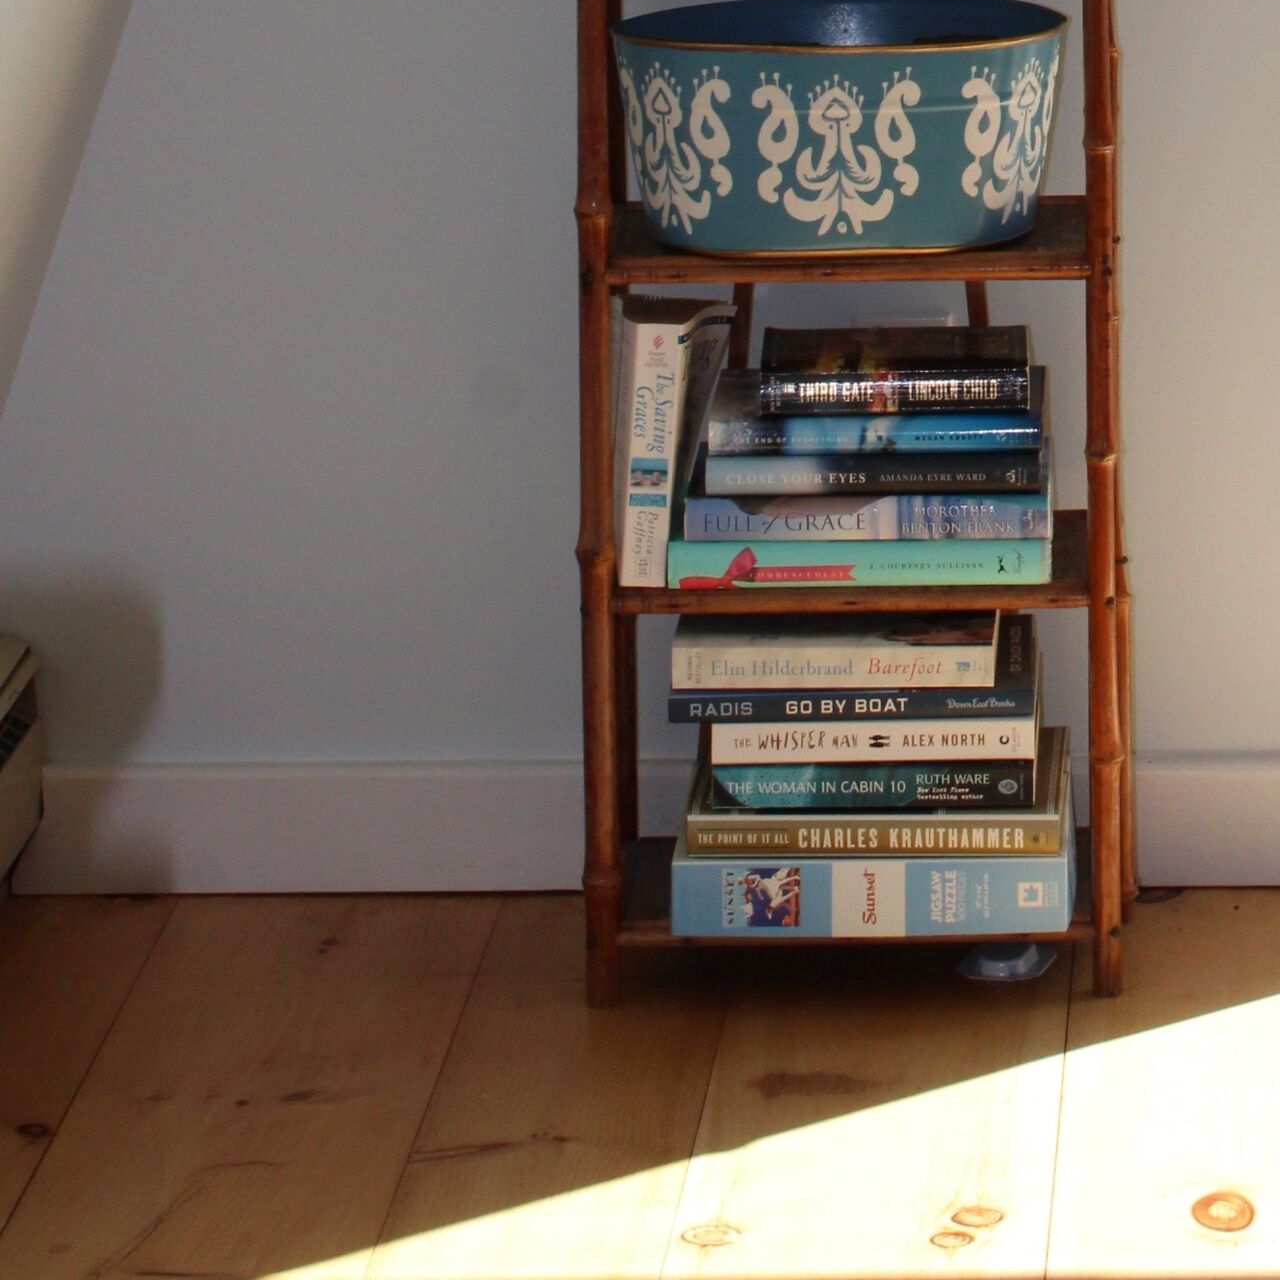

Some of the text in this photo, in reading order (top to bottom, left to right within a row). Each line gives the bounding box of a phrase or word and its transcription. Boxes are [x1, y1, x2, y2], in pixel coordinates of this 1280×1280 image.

[655, 372, 676, 395] The
[799, 382, 838, 403] THIRD
[842, 381, 874, 402] GATE
[908, 380, 959, 401] LINCOLN
[962, 379, 998, 400] CHILD
[633, 386, 655, 439] Graces
[647, 397, 674, 454] Saving
[755, 436, 773, 444] END
[776, 436, 787, 444] OF
[726, 472, 867, 485] CLOSE YOUR EYES
[879, 471, 986, 482] AMANDA EYRE WARD
[914, 505, 998, 518] DOROTHEA
[632, 511, 648, 555] Gaffney
[645, 511, 659, 555] Patricia
[703, 512, 866, 535] FULL of GRACE
[902, 521, 1016, 534] BENTON FRANK
[880, 562, 931, 570] COURTNEY
[711, 658, 854, 677] Elin Hilderbrand
[867, 657, 944, 682] Barefoot
[689, 702, 753, 718] RADIS
[785, 697, 909, 715] GO BY BOAT
[734, 730, 859, 751] THE WHISPER MAN
[902, 733, 986, 747] ALEX NORTH
[727, 780, 907, 794] THE WOMAN IN CABIN 10
[916, 773, 991, 785] RUTH WARE
[698, 833, 790, 844] THE POINT OF IT ALL
[798, 827, 879, 849] CHARLES
[889, 827, 1025, 849] KRAUTHAMMER
[726, 871, 736, 926] SUNSET
[862, 868, 877, 925] Sunset
[930, 870, 943, 923] JIGSAW
[945, 870, 958, 924] PUZZLE
